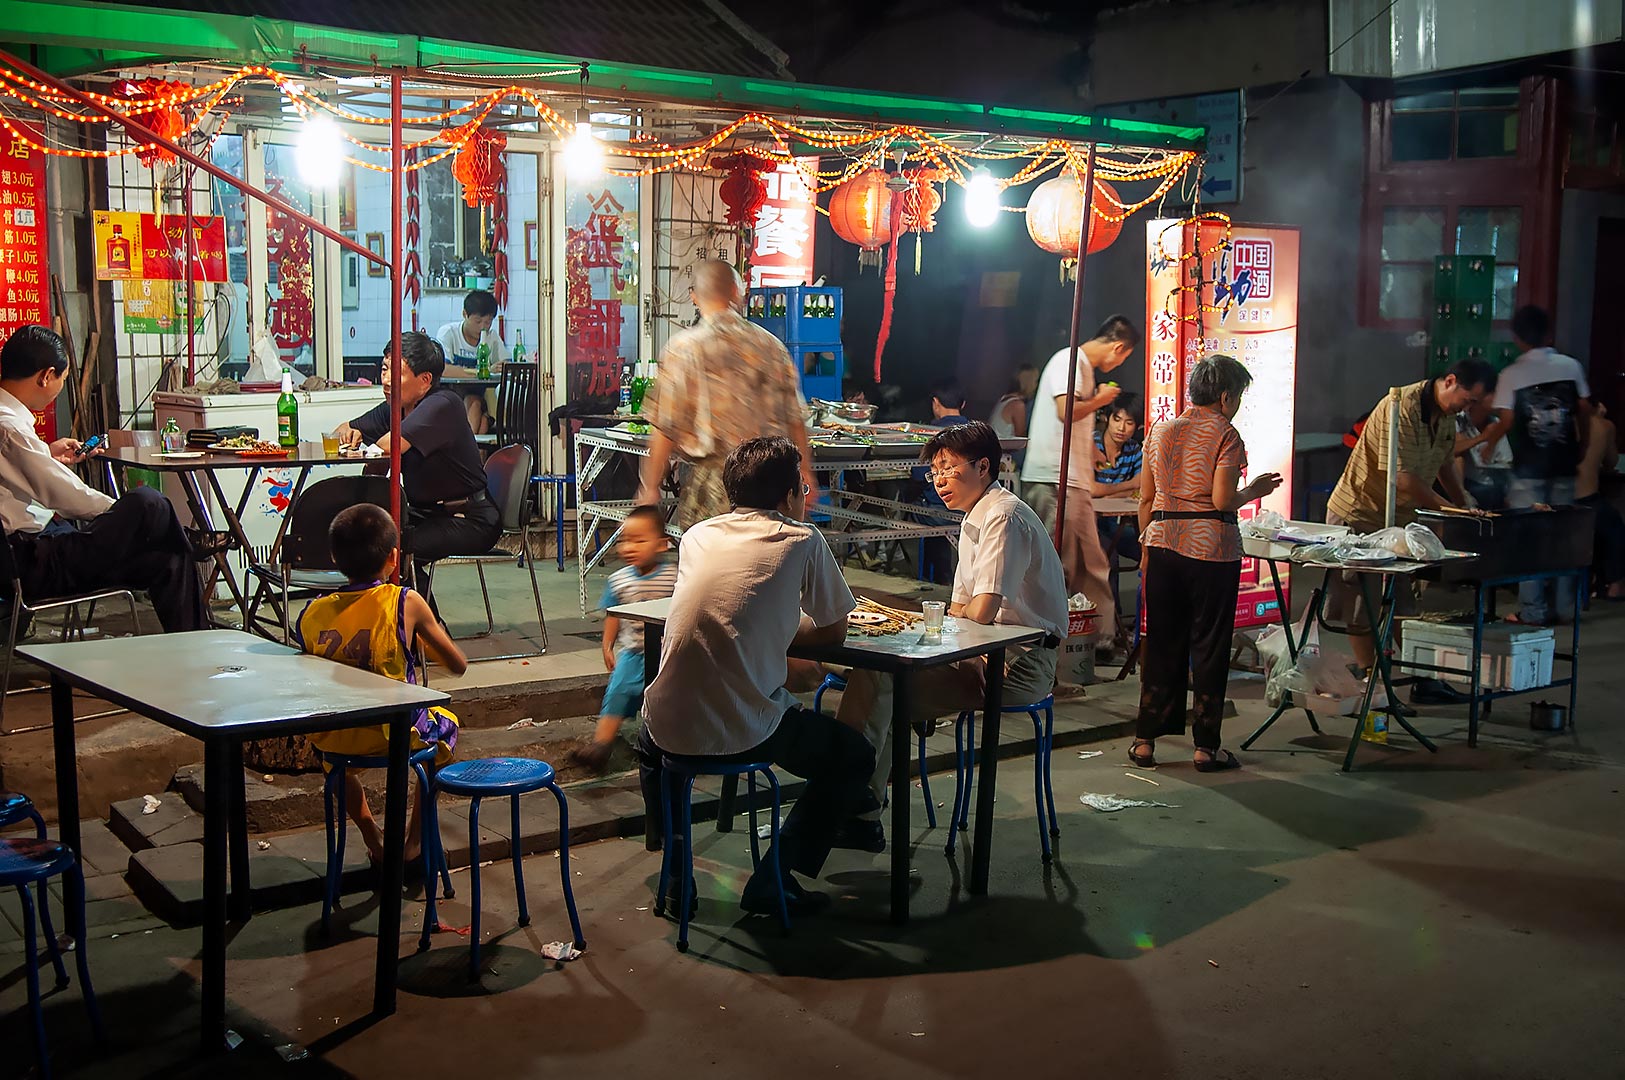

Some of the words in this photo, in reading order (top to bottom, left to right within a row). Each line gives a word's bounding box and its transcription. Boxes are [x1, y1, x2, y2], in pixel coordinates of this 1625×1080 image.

[0, 139, 29, 159] 店
[0, 190, 35, 206] 油0.5元
[1235, 242, 1271, 268] 中国
[1153, 311, 1177, 423] 家常菜
[318, 629, 372, 669] 24
